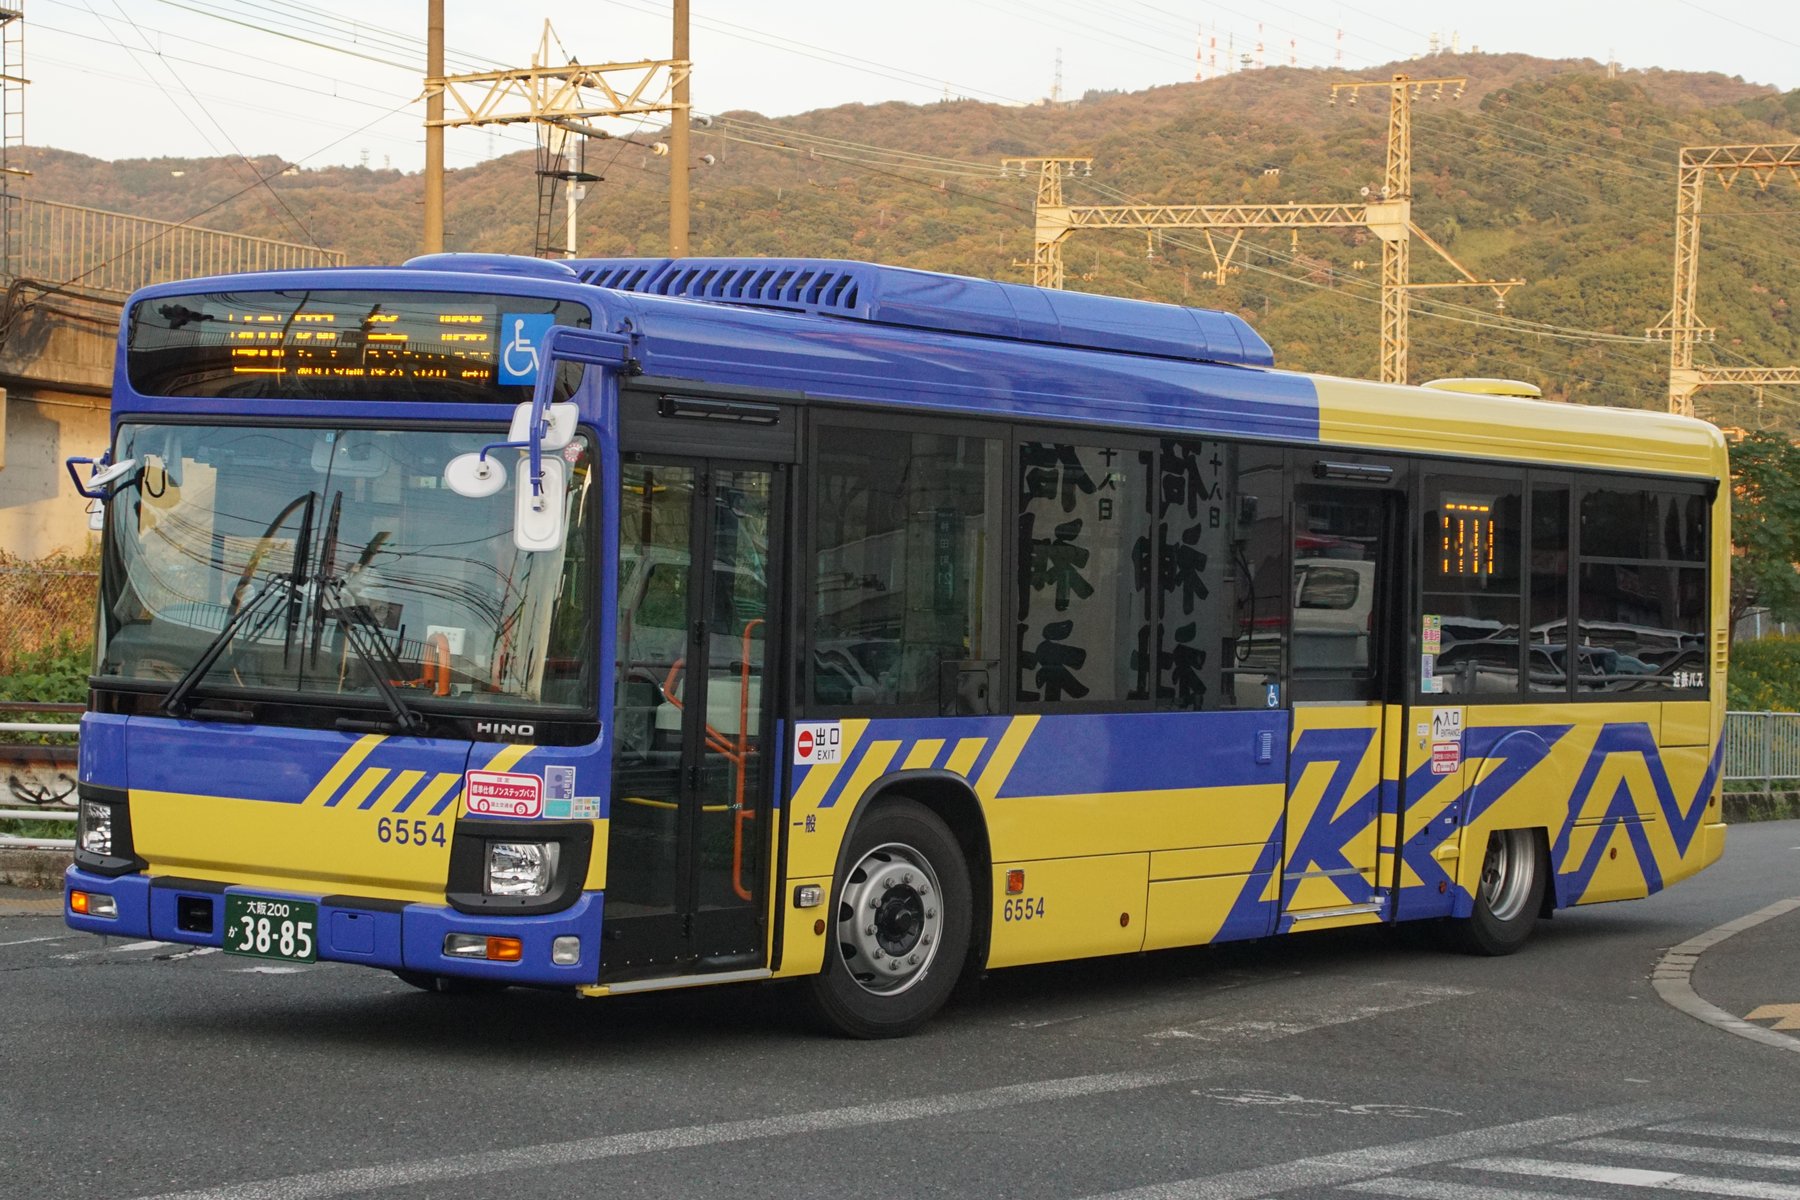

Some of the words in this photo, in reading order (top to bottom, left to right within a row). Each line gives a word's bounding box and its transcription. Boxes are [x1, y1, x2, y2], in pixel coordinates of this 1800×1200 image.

[1673, 671, 1704, 687] 近鉄バス
[1443, 711, 1459, 726] 入口
[477, 722, 535, 736] HINO
[815, 727, 839, 746] 出口
[817, 750, 835, 760] EXIT
[472, 784, 536, 799] 標準仕様ノンステップバス
[563, 769, 573, 799] PiTaPa
[377, 817, 446, 848] 6554
[793, 814, 816, 833] 一般
[1004, 896, 1045, 922] 6554
[239, 915, 313, 958] 38-85
